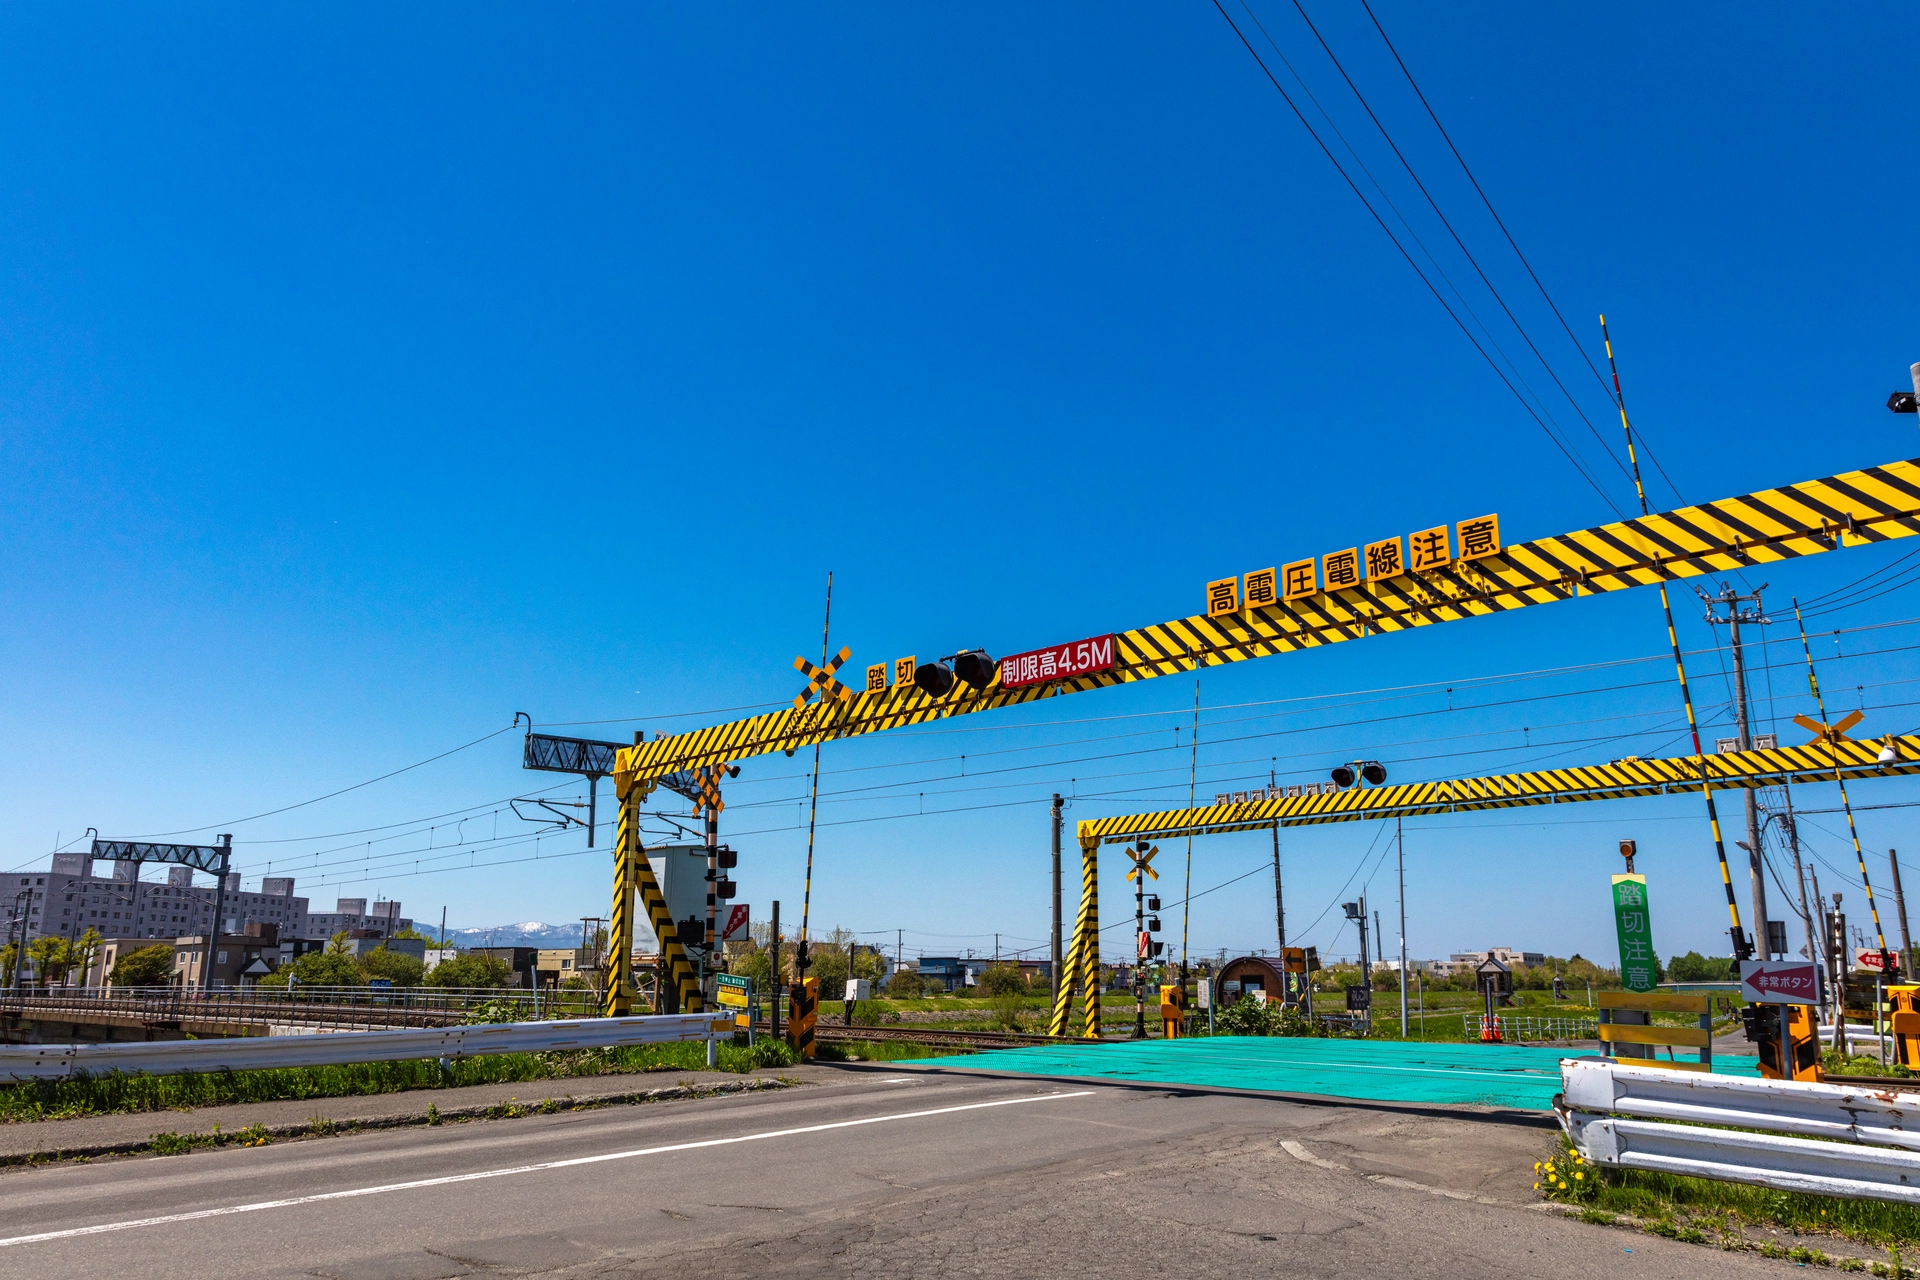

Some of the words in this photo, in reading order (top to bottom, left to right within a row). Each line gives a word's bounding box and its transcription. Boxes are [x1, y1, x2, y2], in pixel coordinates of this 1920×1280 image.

[1209, 519, 1497, 616] 高電圧電線注意
[868, 661, 914, 690] 踏切
[1002, 638, 1112, 685] 制限高4.5M
[1618, 883, 1652, 990] 踏切注意
[1758, 975, 1812, 989] 非常ボタン
